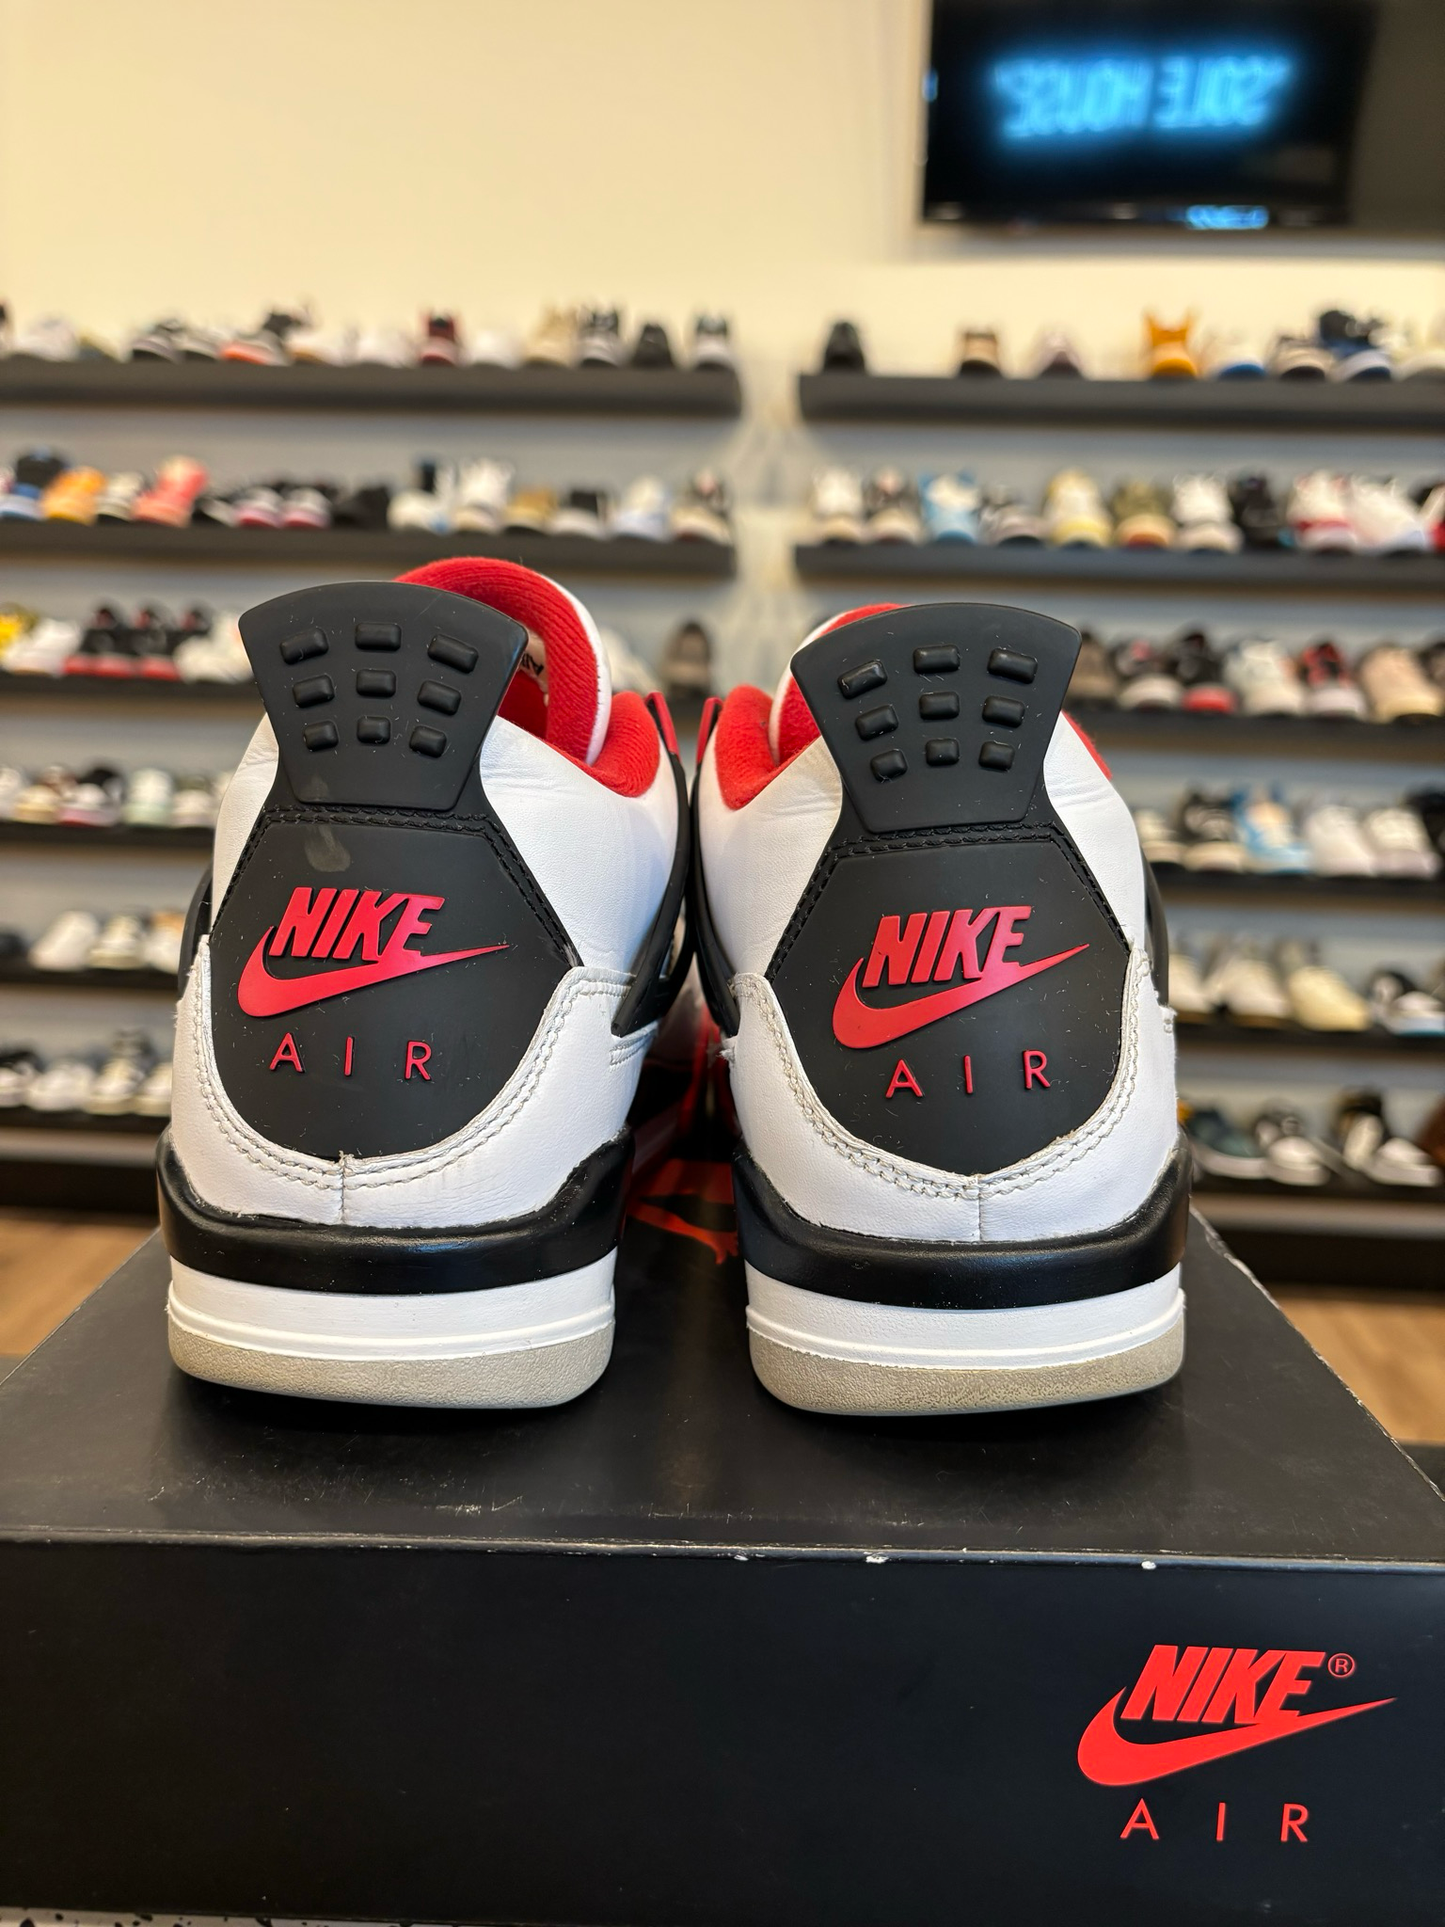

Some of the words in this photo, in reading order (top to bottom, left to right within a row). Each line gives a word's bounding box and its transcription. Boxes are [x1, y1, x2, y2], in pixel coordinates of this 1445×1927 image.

[269, 886, 446, 963] NIKE
[861, 904, 1033, 988] NIKE
[269, 1032, 432, 1081] AIR
[885, 1049, 1051, 1098] AIR
[1119, 1798, 1309, 1843] AIR
